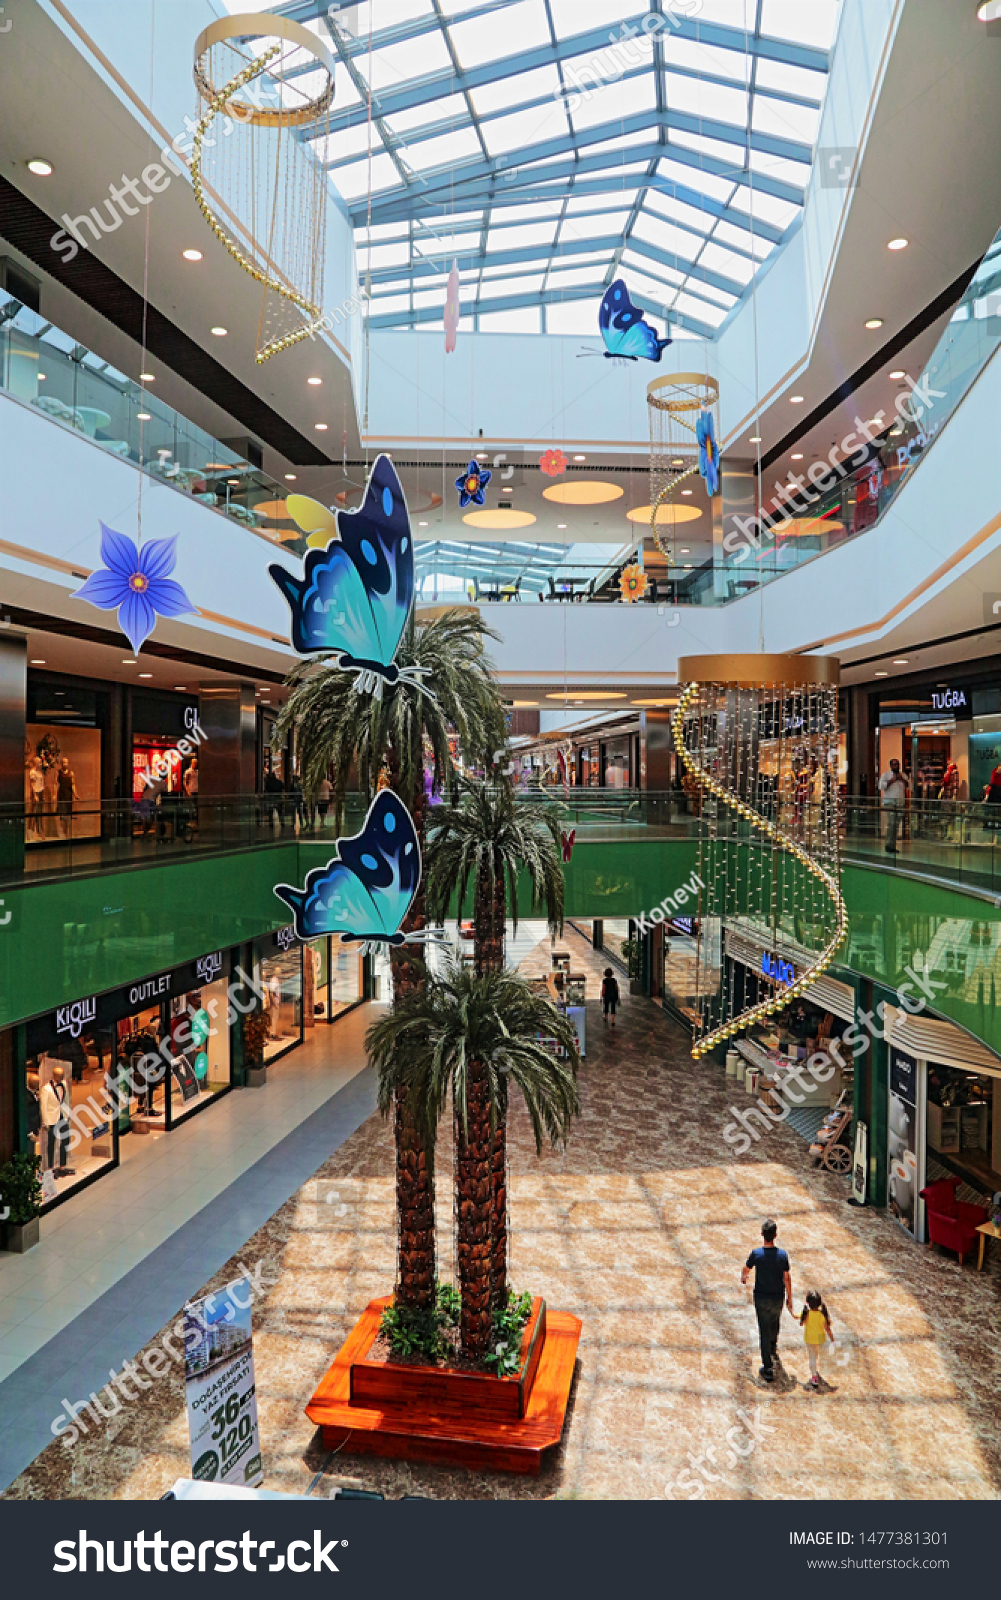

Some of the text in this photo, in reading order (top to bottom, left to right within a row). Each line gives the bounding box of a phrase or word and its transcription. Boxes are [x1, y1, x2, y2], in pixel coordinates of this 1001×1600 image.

[932, 688, 967, 709] TUĞBA
[130, 975, 171, 1004] OUTLET
[211, 1392, 239, 1441] 36
[219, 1414, 251, 1463] 120
